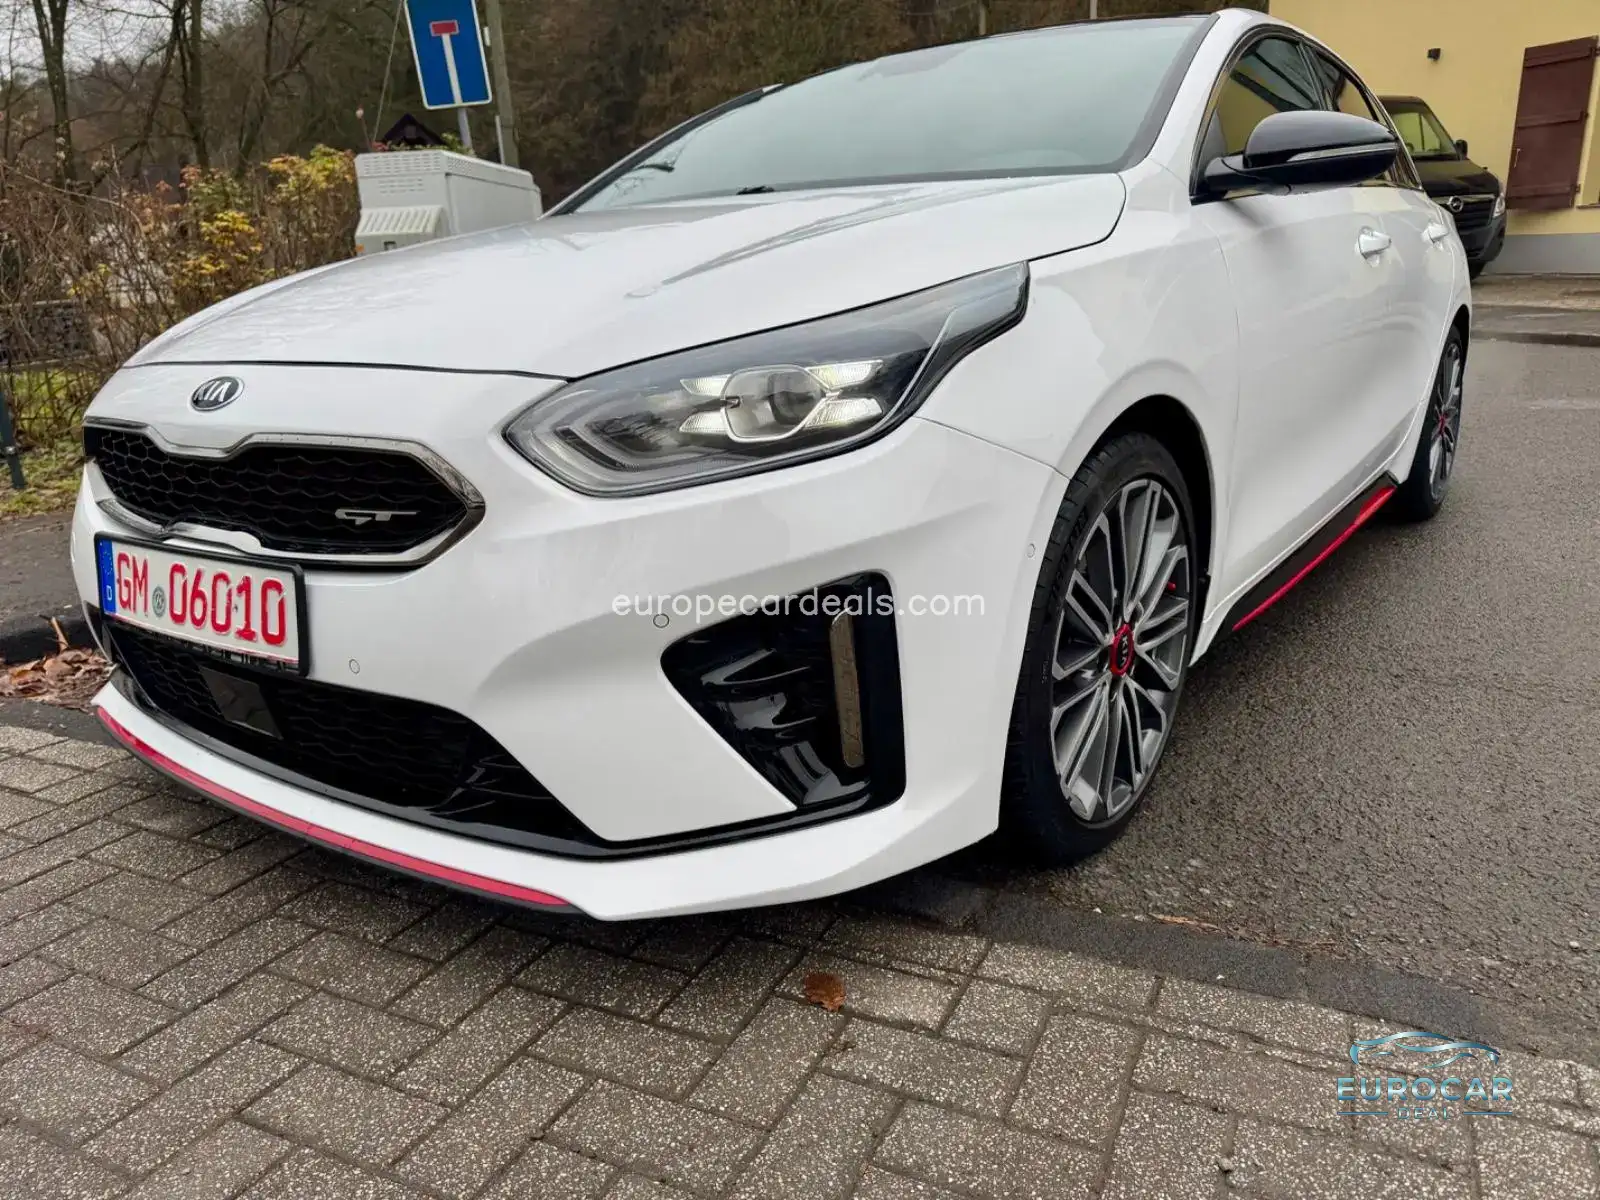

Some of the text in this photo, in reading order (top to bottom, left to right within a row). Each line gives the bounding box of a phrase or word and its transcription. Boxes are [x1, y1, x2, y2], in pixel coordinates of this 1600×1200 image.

[194, 380, 232, 402] KIA
[335, 509, 417, 525] GT
[106, 585, 112, 600] D
[117, 552, 286, 646] GM 06010
